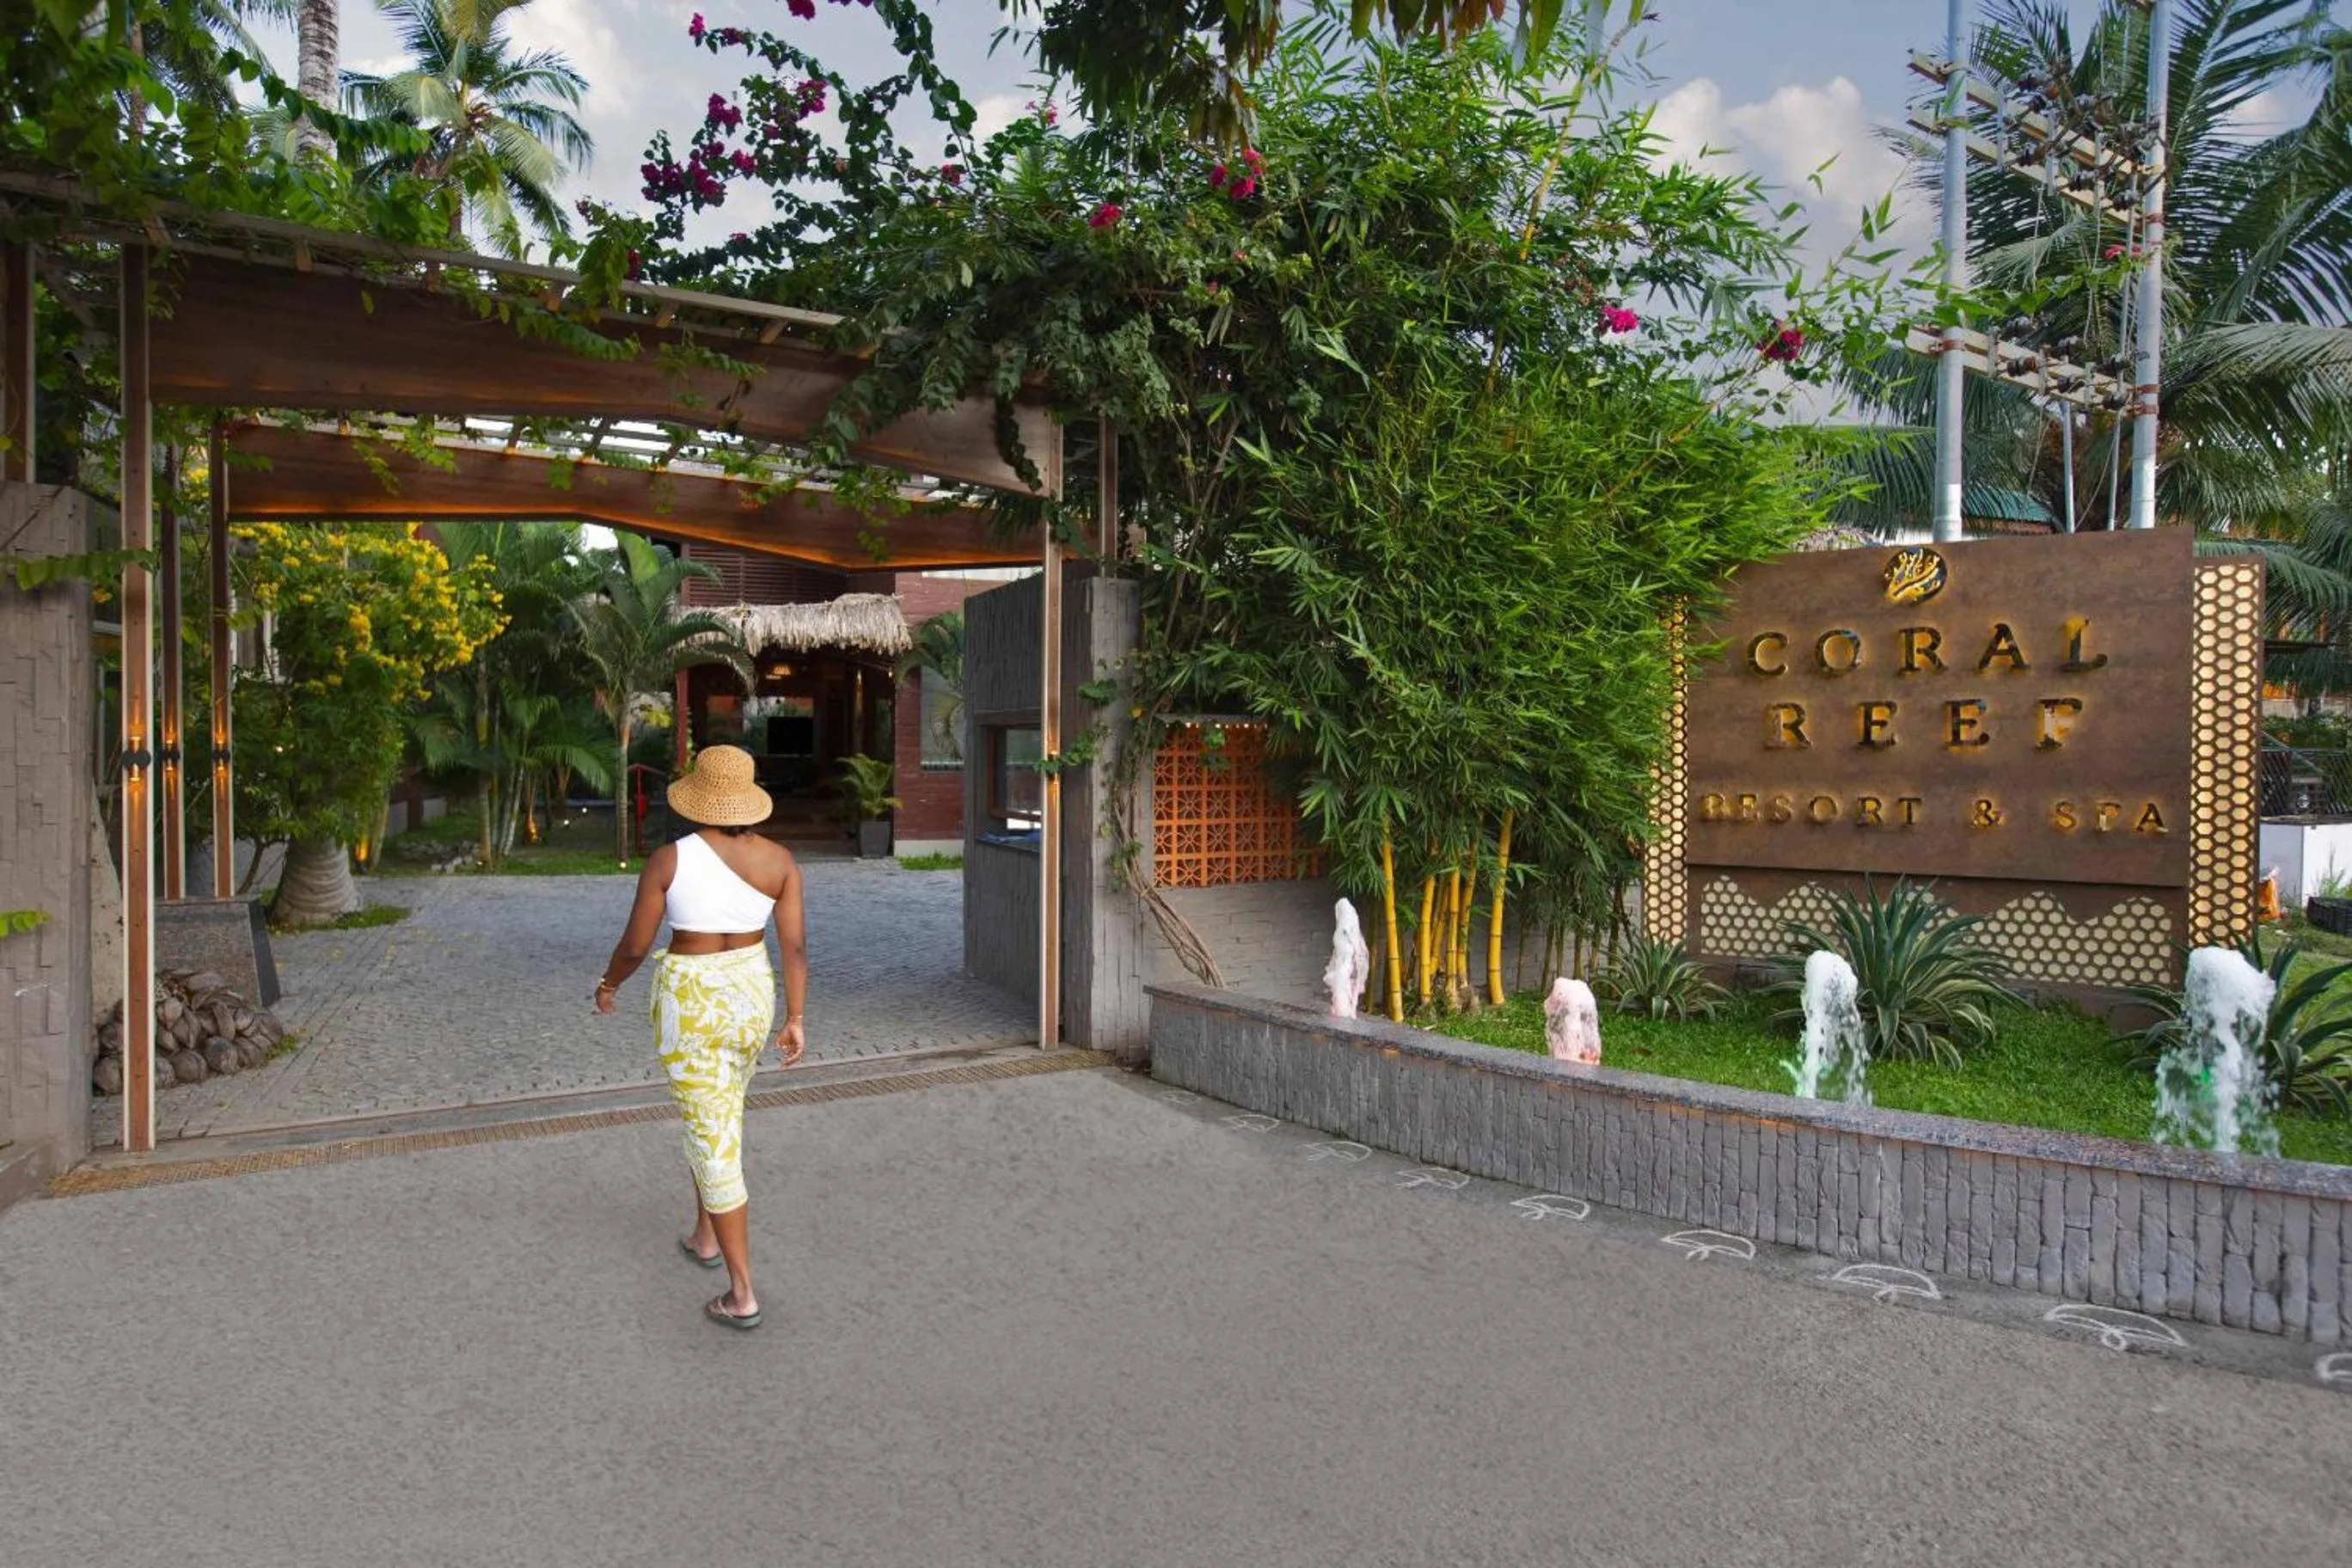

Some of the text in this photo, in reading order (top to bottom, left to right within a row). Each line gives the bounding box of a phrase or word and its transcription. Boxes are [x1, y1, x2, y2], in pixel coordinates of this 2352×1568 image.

[1746, 617, 2109, 677] CORAL
[1763, 695, 2085, 752] REEF
[1700, 792, 2170, 834] RESORT & SPA
